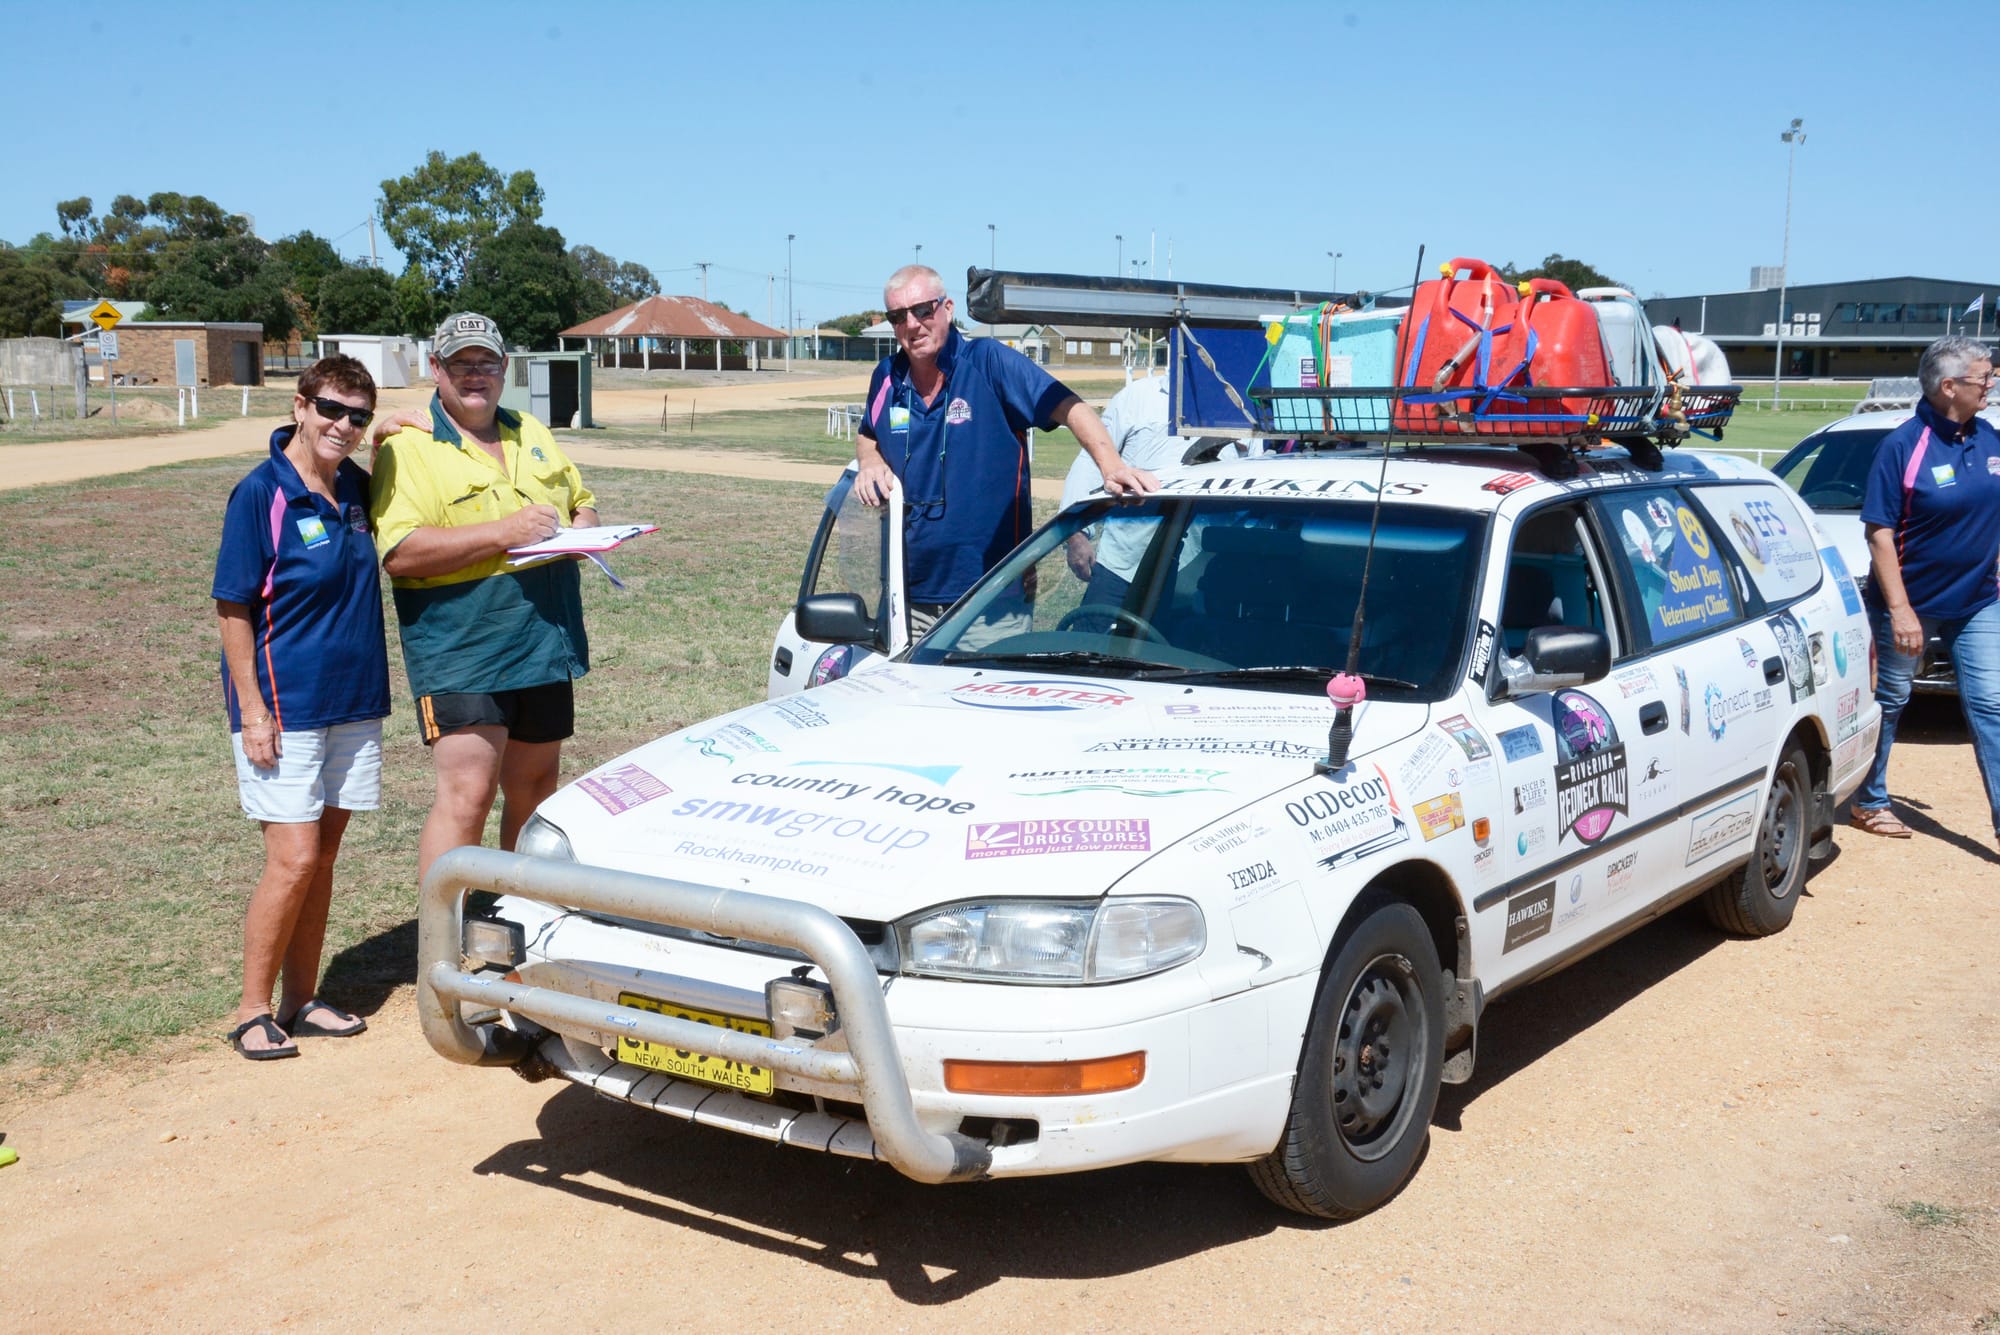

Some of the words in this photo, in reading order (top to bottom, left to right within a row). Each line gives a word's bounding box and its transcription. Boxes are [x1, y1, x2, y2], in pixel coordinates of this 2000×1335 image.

[460, 320, 482, 329] CAT
[1744, 501, 1787, 537] EFS
[1669, 566, 1701, 593] Shoal
[1699, 565, 1722, 590] Bay
[1659, 601, 1707, 628] Veterinary
[1705, 593, 1729, 616] Clinic
[952, 683, 1135, 706] HUNTER
[1082, 741, 1329, 756] Automotive
[1570, 751, 1614, 783] RIVERINA
[731, 772, 871, 800] country
[873, 785, 976, 815] hope
[1285, 777, 1386, 826] OCDecor
[1558, 777, 1600, 835] REDNECK
[1600, 767, 1627, 806] RALLY
[1024, 819, 1148, 834] DISCOUNT
[1024, 832, 1073, 846] DRUG
[1081, 831, 1148, 843] STORES
[1309, 829, 1326, 844] M:
[1324, 819, 1351, 839] 0404
[1351, 810, 1370, 829] 435
[1369, 804, 1388, 823] 785
[673, 840, 829, 877] Rockhampton
[970, 848, 1010, 859] more
[1011, 846, 1043, 855] than
[1046, 844, 1073, 854] just
[1076, 842, 1101, 852] low
[1103, 842, 1146, 852] prices
[1227, 860, 1278, 890] YENDA
[1508, 897, 1549, 928] HAWKINS
[634, 1052, 661, 1068] NEW
[667, 1059, 706, 1079] SOUTH
[711, 1067, 752, 1089] WALES
